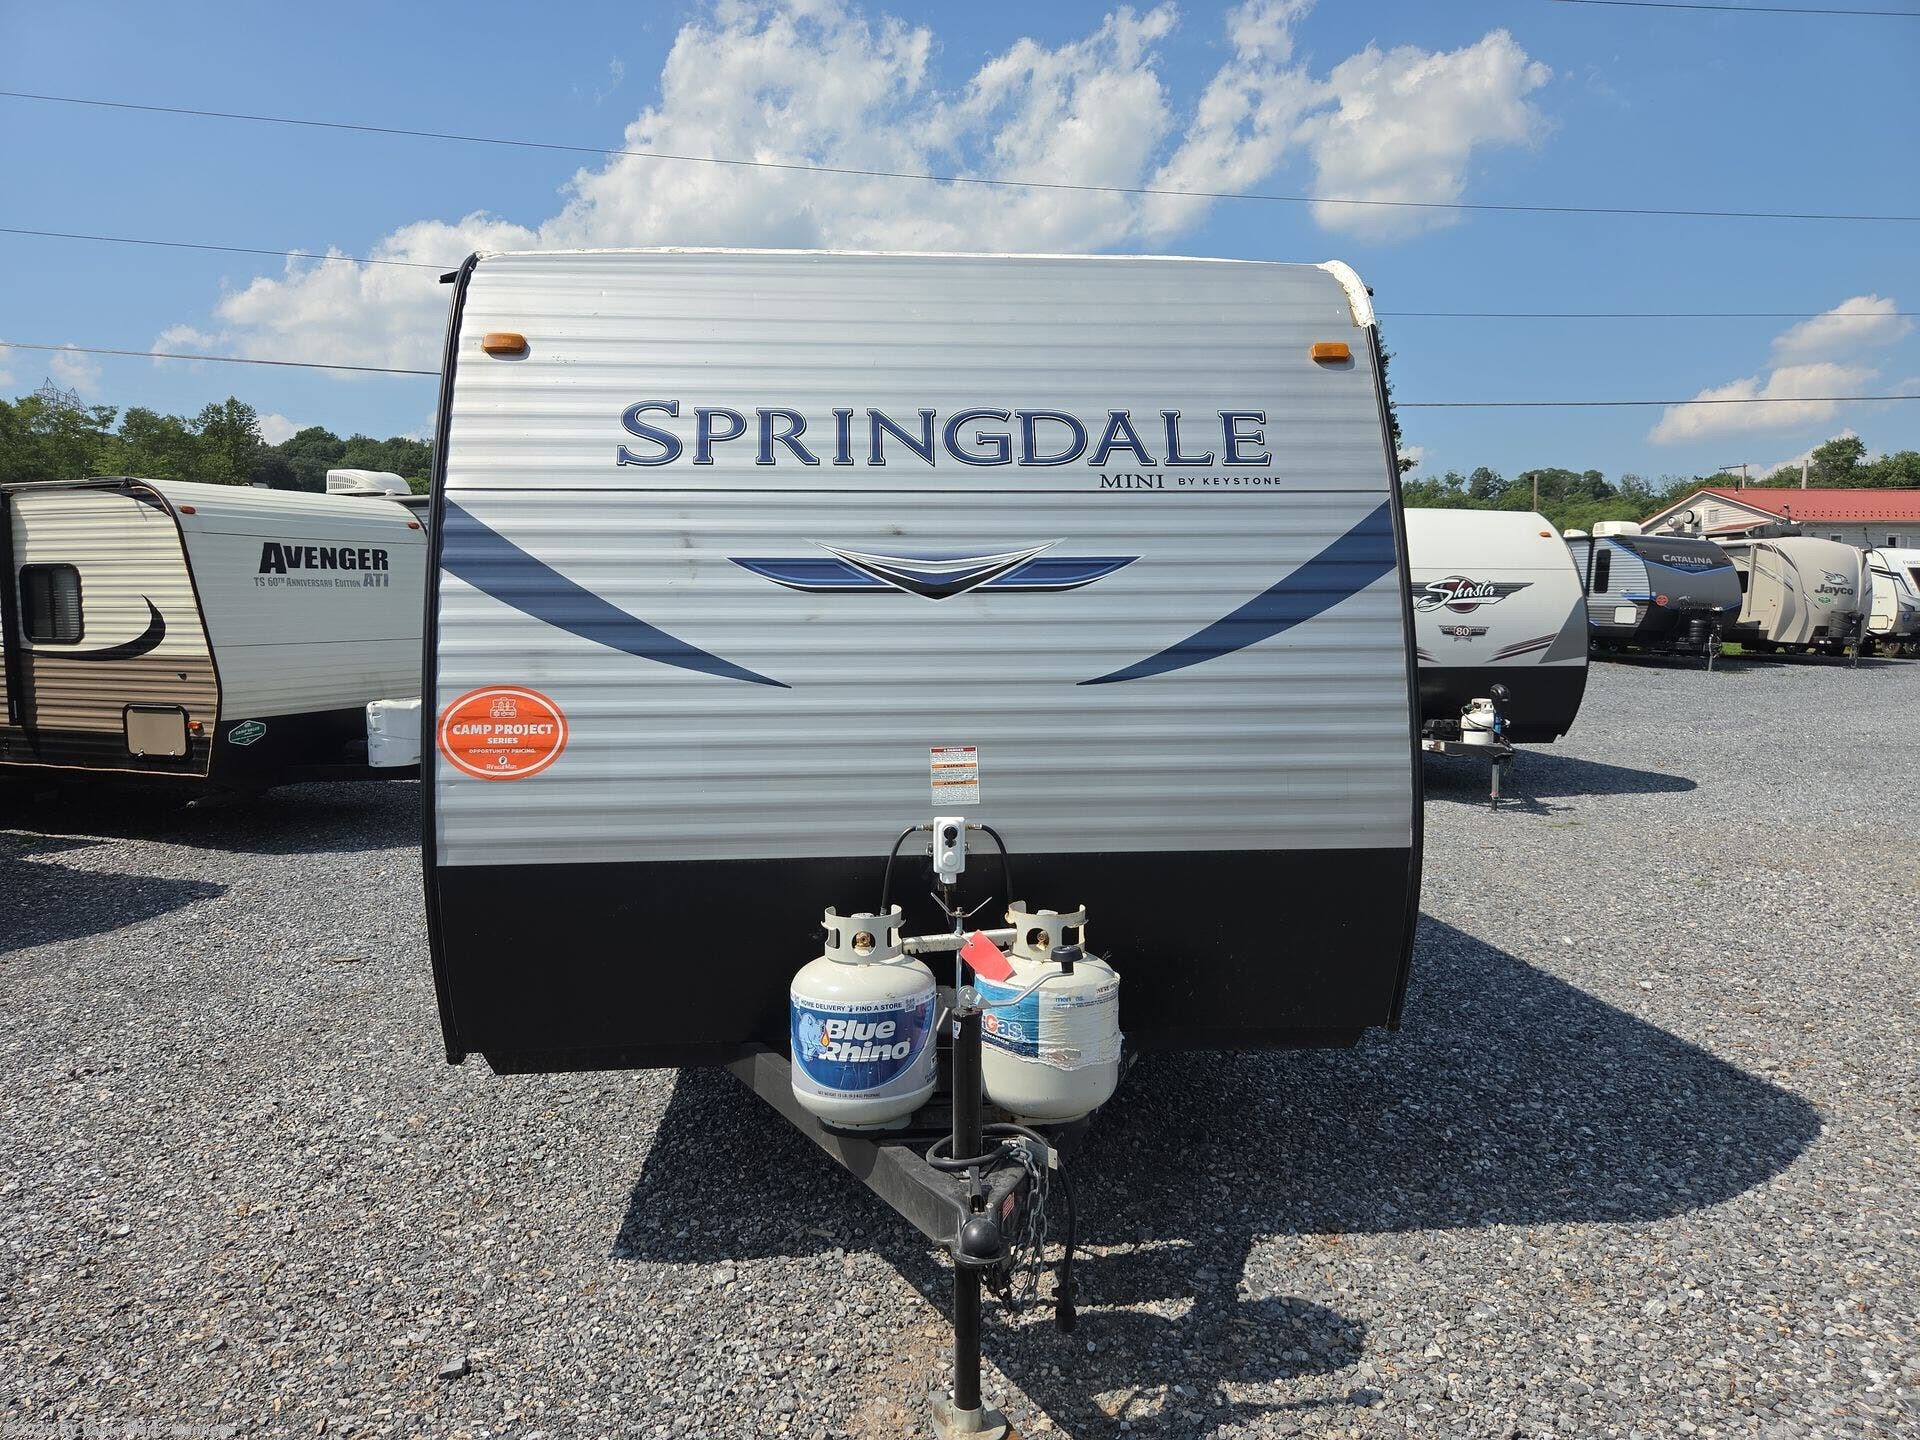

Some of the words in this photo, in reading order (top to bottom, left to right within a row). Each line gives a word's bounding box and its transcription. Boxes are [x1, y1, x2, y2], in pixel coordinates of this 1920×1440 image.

[616, 400, 1274, 467] SPRINGDALE
[1099, 474, 1165, 489] MINI
[1178, 477, 1195, 486] BY
[1203, 477, 1282, 486] KEYSTONE
[259, 542, 389, 574] AVENGER
[1662, 554, 1713, 565] CATALINA
[362, 572, 389, 588] ATI
[1416, 579, 1496, 612] Shasta
[1814, 583, 1854, 596] Jayco
[1455, 627, 1470, 636] 80
[452, 724, 492, 735] CAMP
[495, 723, 554, 736] PROJECT
[487, 737, 519, 745] SERIES
[815, 1003, 846, 1012] DELIVERY
[880, 1003, 903, 1011] STORE
[825, 1019, 896, 1040] Blue
[819, 1041, 910, 1063] Rhino
